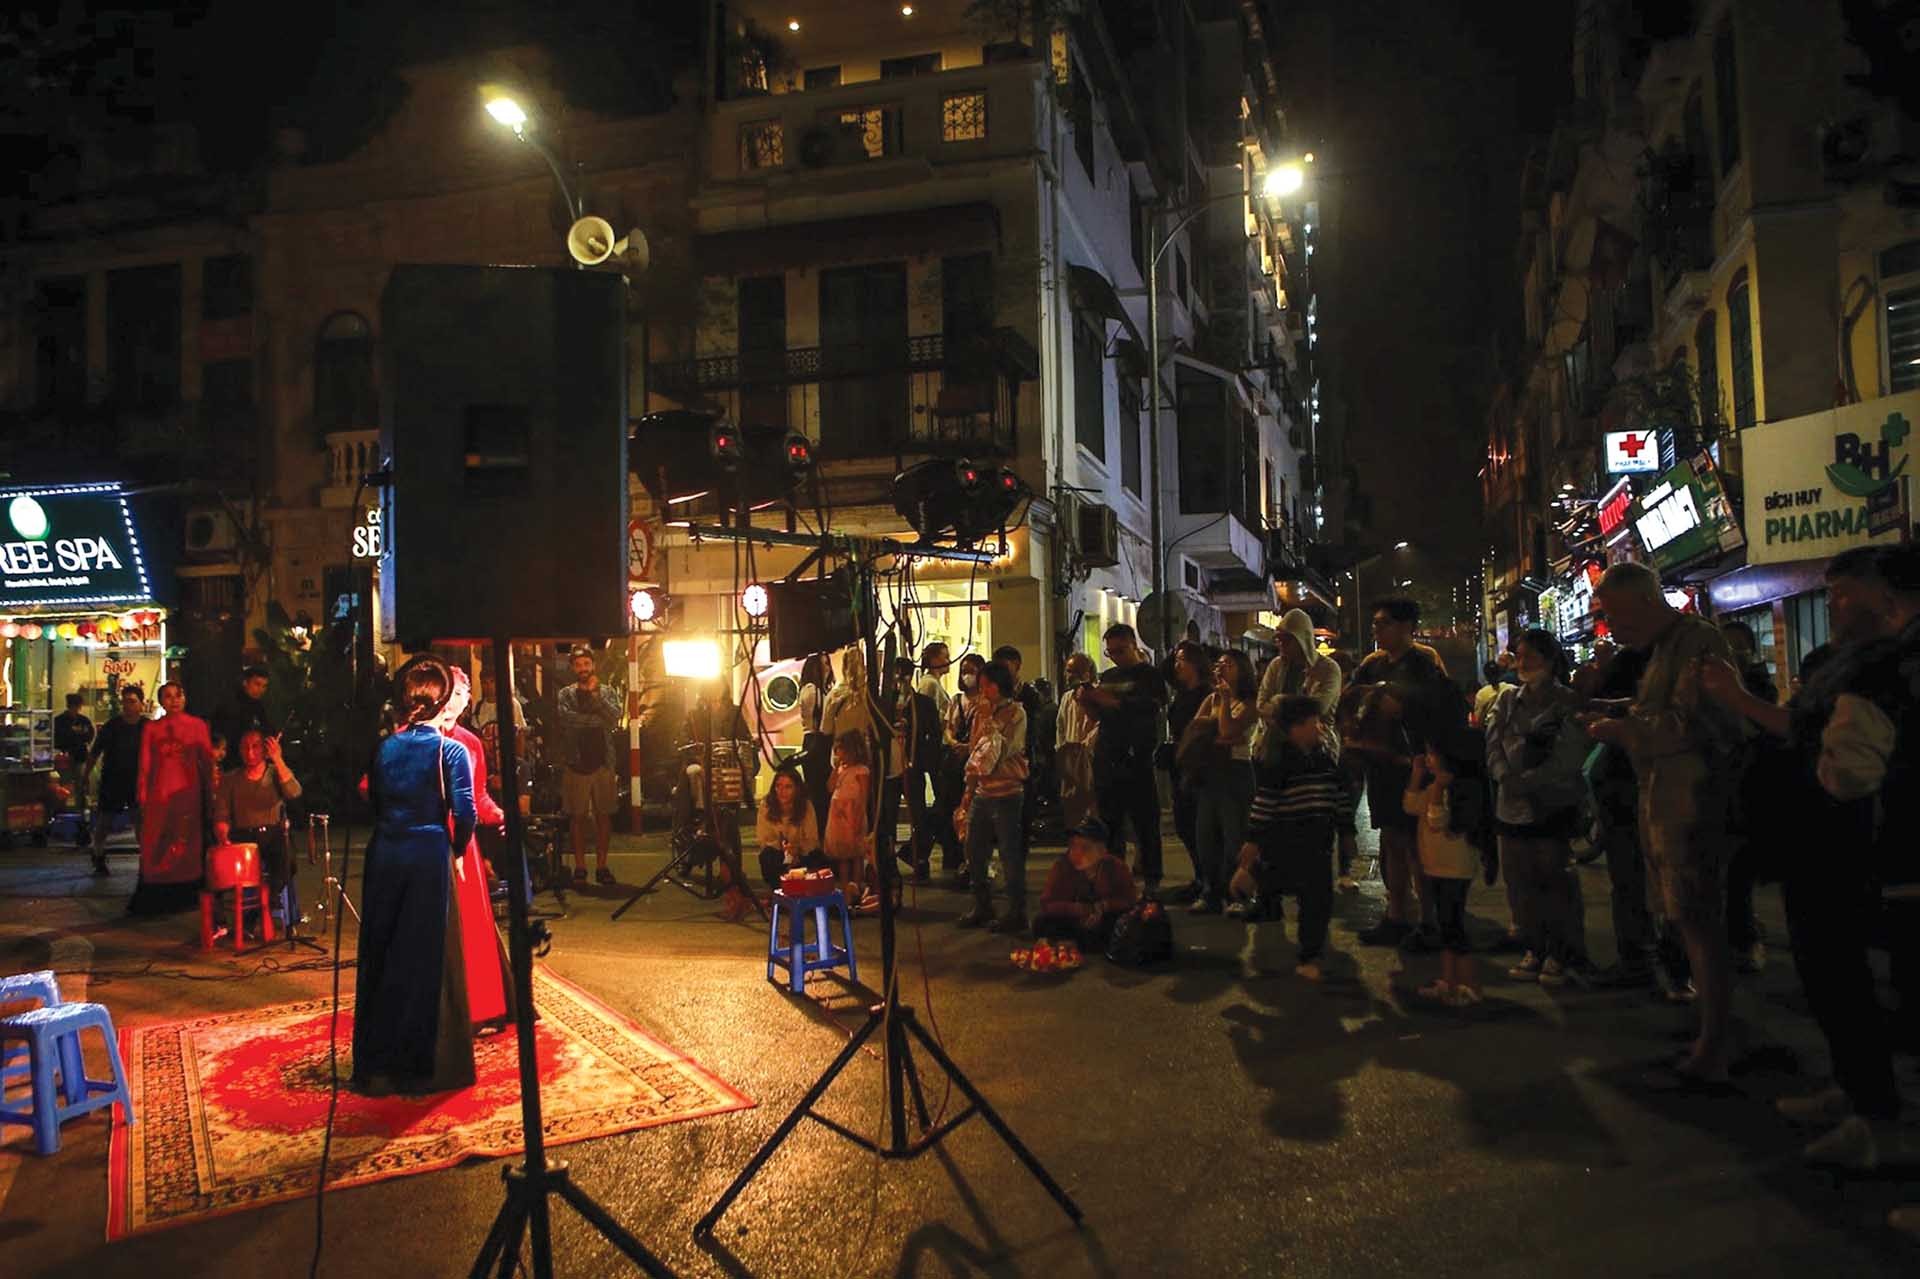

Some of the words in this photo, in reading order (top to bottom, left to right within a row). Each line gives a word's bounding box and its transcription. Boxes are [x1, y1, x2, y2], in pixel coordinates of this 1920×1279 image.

[1765, 491, 1793, 510] BÍCH
[1795, 488, 1822, 507] HUY
[55, 536, 122, 572] SPA
[103, 659, 136, 677] Body
